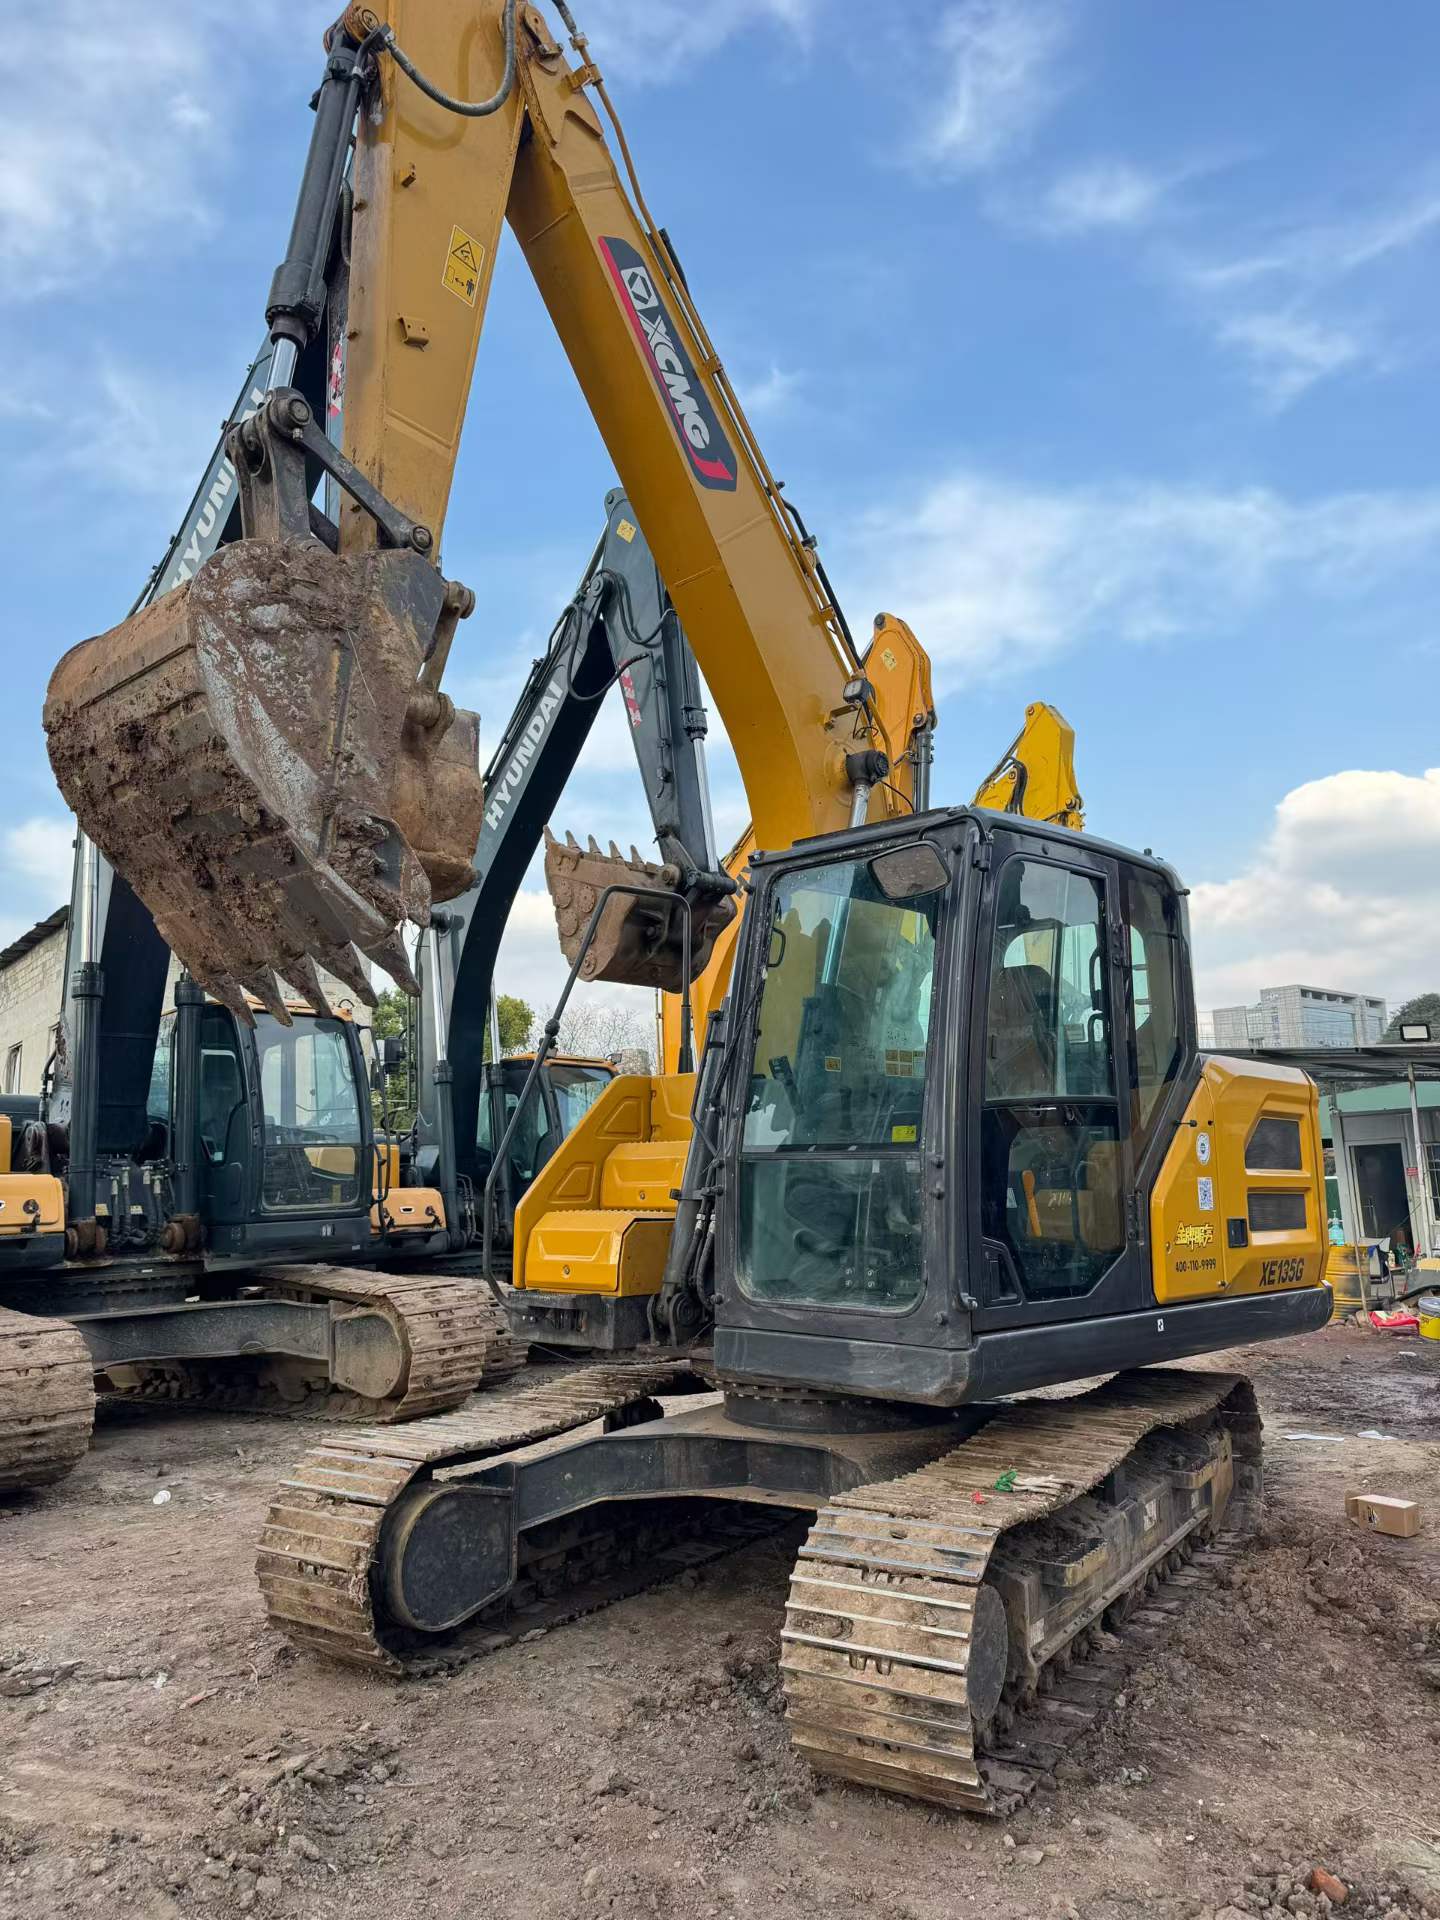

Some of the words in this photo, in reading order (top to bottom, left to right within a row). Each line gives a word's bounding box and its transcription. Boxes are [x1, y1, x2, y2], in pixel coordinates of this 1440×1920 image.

[637, 312, 710, 449] XCMG
[485, 680, 563, 831] HYUNDAI
[1175, 1258, 1216, 1272] 400-110-9999
[1259, 1257, 1304, 1287] XE135G
